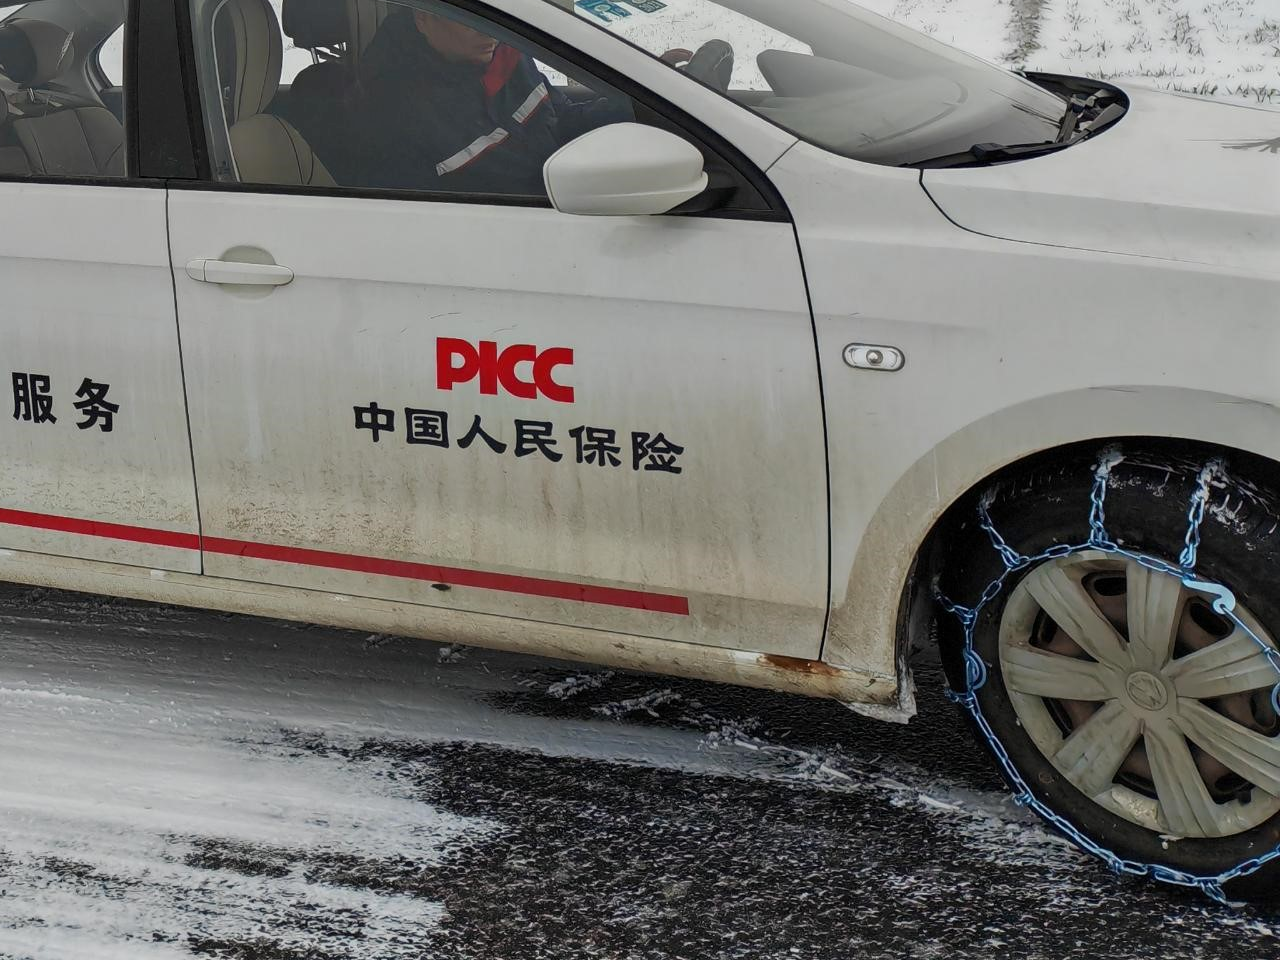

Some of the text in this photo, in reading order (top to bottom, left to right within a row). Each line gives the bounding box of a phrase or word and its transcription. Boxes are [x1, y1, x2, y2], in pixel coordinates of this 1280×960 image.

[436, 337, 575, 403] PICC
[352, 401, 686, 475] 中国人民保险
